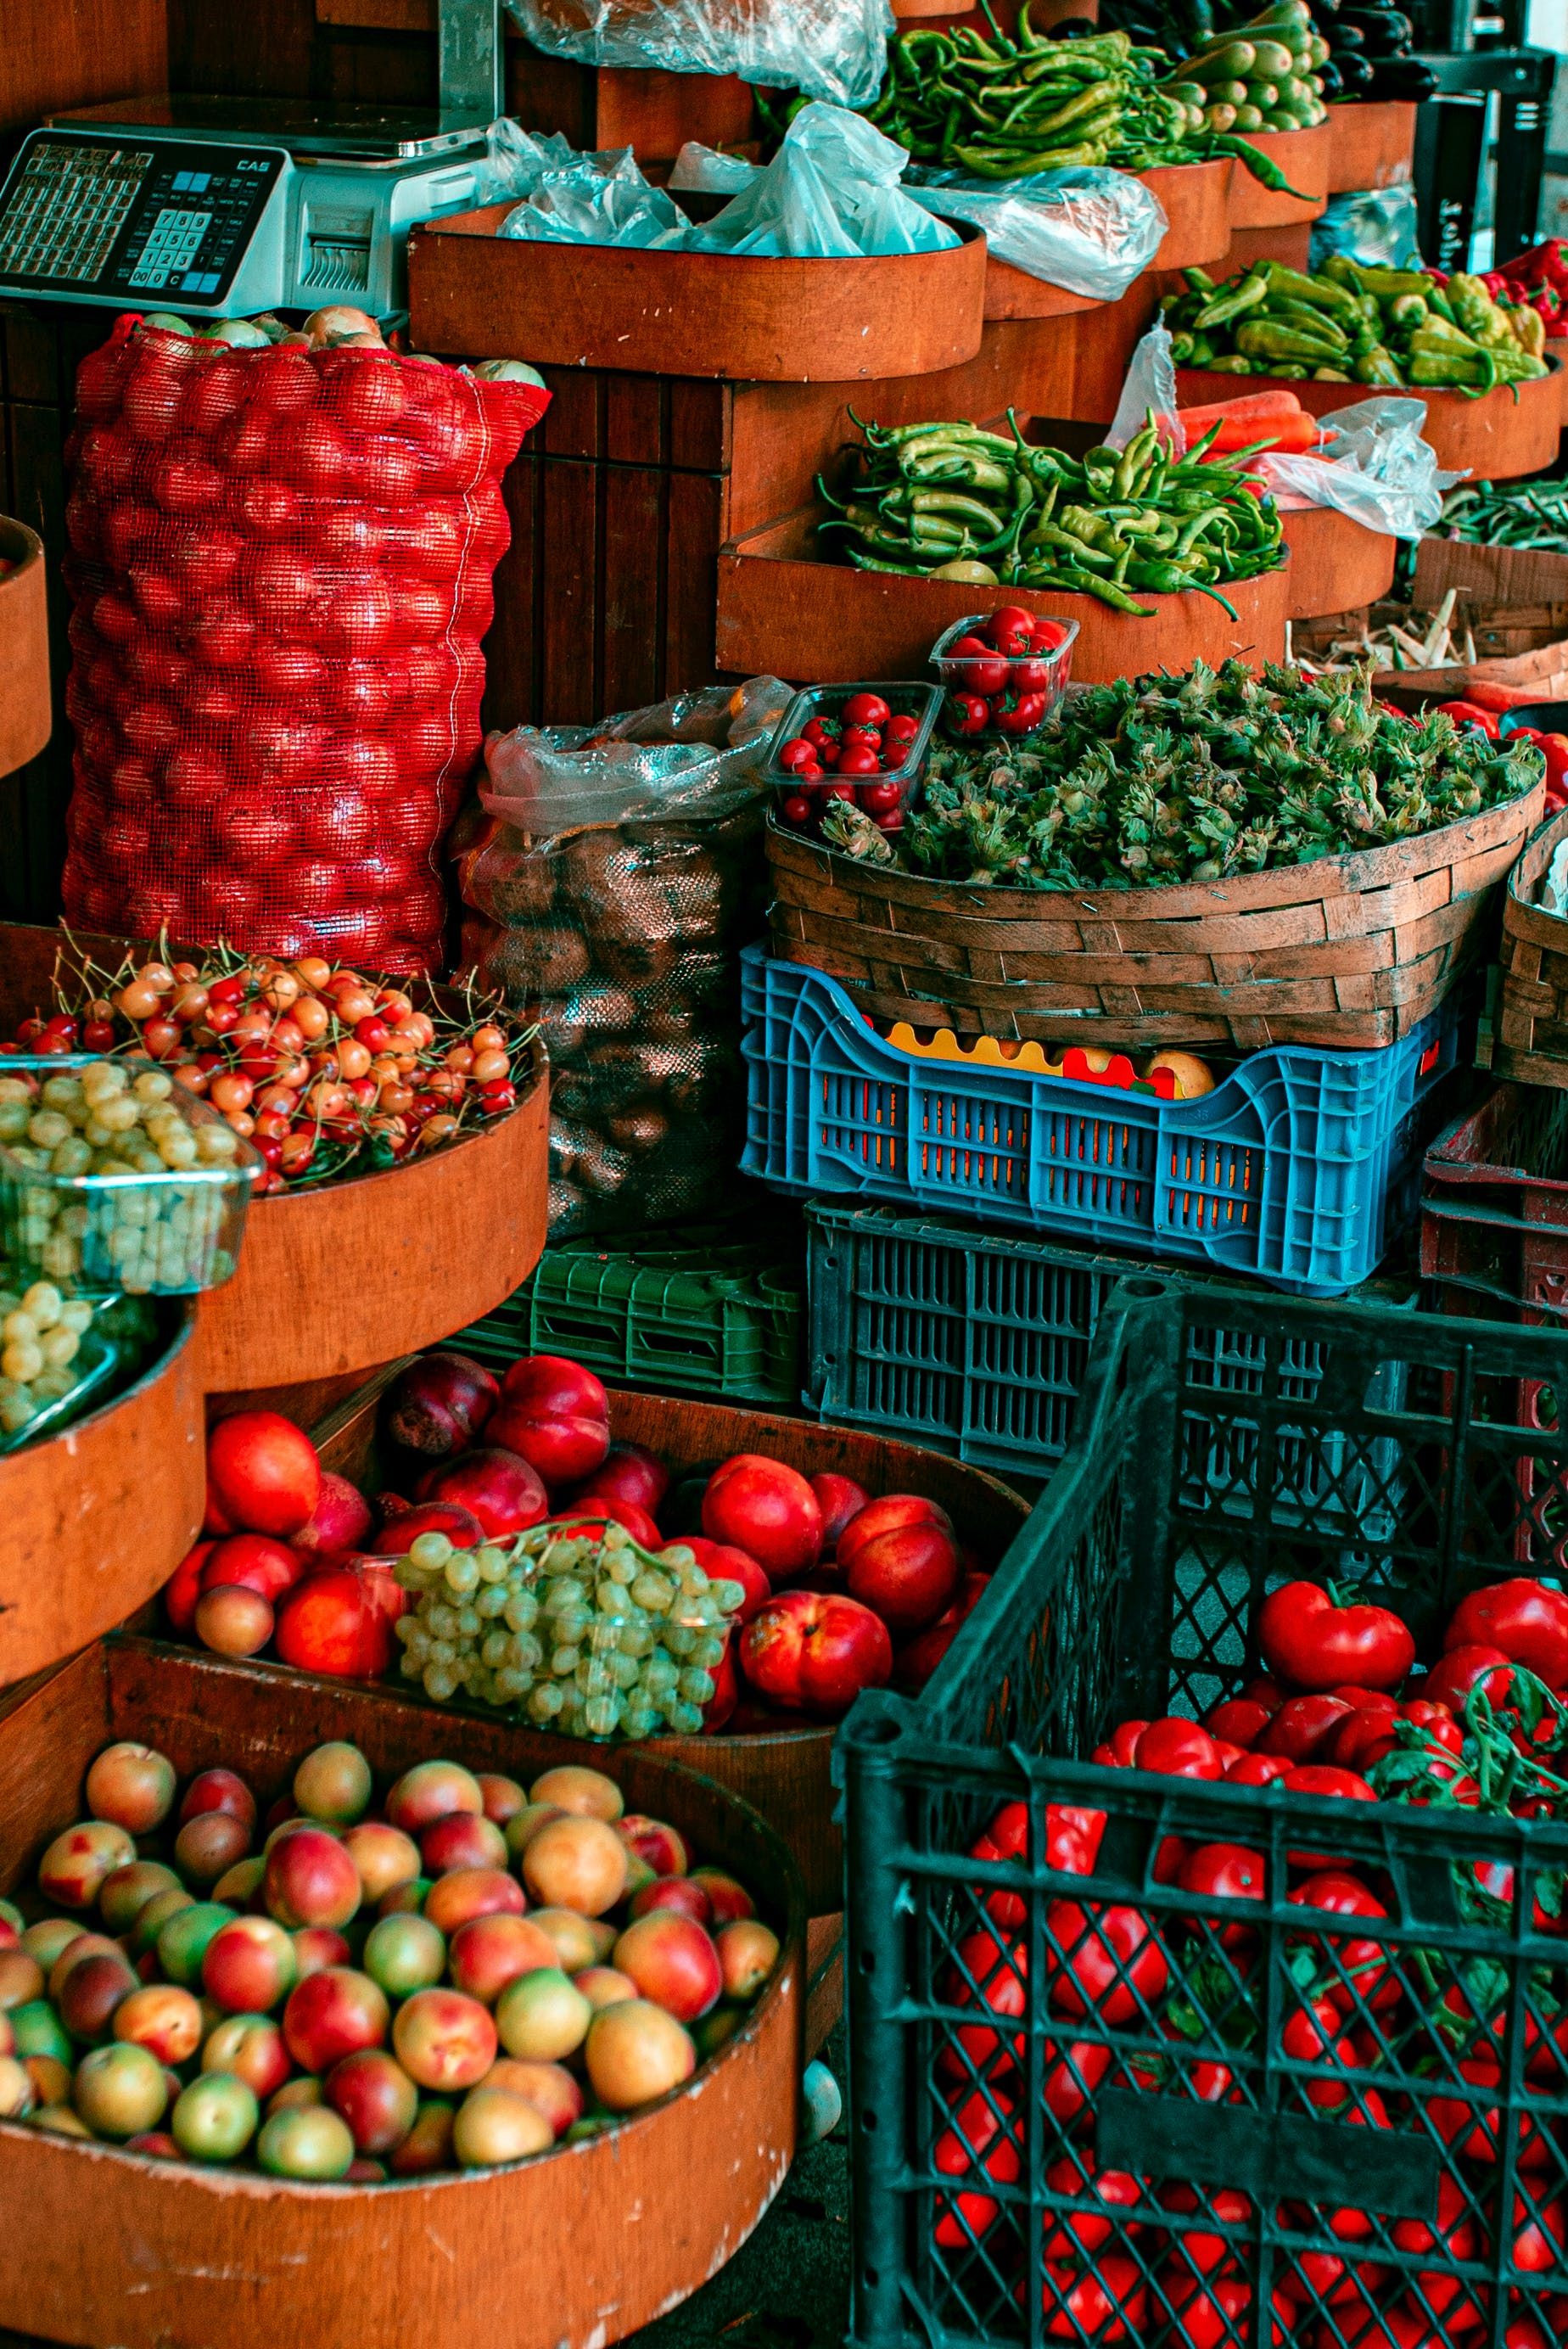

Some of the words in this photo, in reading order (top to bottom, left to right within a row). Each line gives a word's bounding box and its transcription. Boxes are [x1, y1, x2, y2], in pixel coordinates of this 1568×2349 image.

[237, 160, 271, 172] CAS
[162, 215, 171, 224] 7
[179, 216, 188, 226] 8
[195, 217, 204, 227] 9
[154, 233, 161, 244] 4
[171, 234, 179, 244] 5
[188, 237, 196, 247] 6
[147, 253, 154, 263] 1
[161, 254, 171, 265] 2
[178, 256, 187, 266] 3
[132, 272, 148, 283] 00
[154, 272, 162, 283] 0
[170, 274, 180, 285] C
